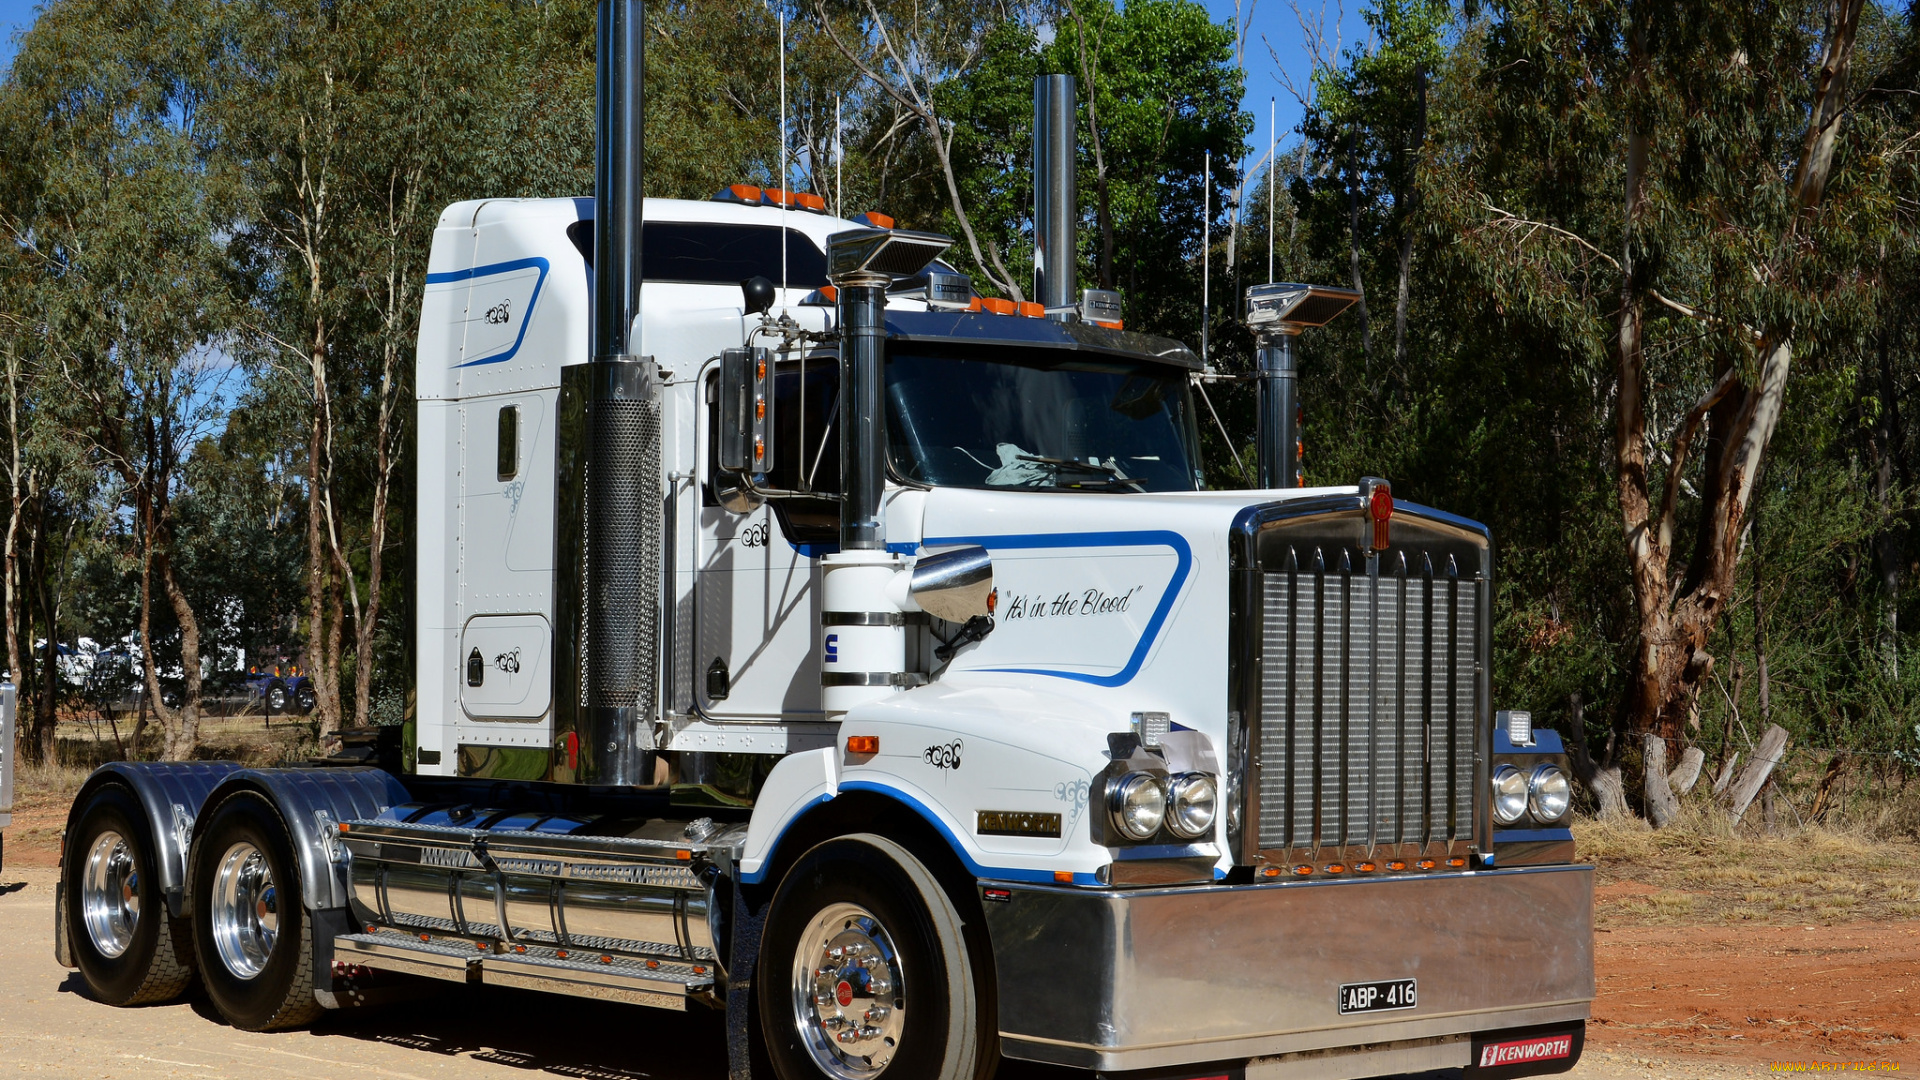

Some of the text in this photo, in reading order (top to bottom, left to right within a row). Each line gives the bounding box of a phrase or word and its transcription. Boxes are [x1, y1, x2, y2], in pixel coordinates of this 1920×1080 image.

[1029, 595, 1047, 618] in
[1051, 592, 1078, 616] the
[978, 812, 1060, 833] KENWORTH
[1498, 1040, 1569, 1062] KENWORTH
